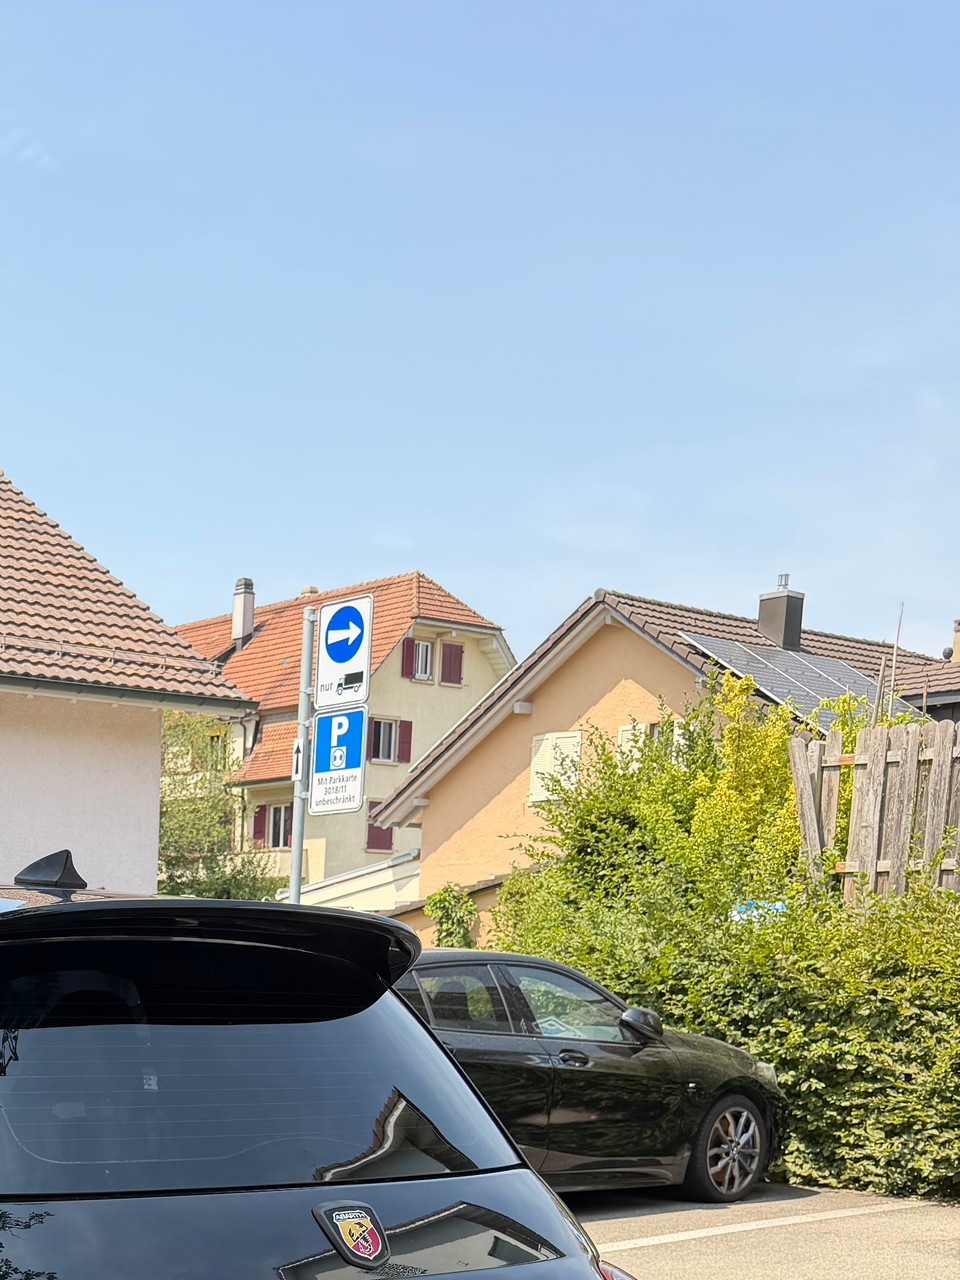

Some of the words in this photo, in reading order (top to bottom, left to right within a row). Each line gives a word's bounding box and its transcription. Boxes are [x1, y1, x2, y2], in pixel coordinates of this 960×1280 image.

[320, 683, 333, 692] nur
[330, 716, 349, 747] P
[317, 777, 327, 785] Mit
[329, 774, 357, 785] Parkkarte
[315, 794, 355, 806] unbeschränkt
